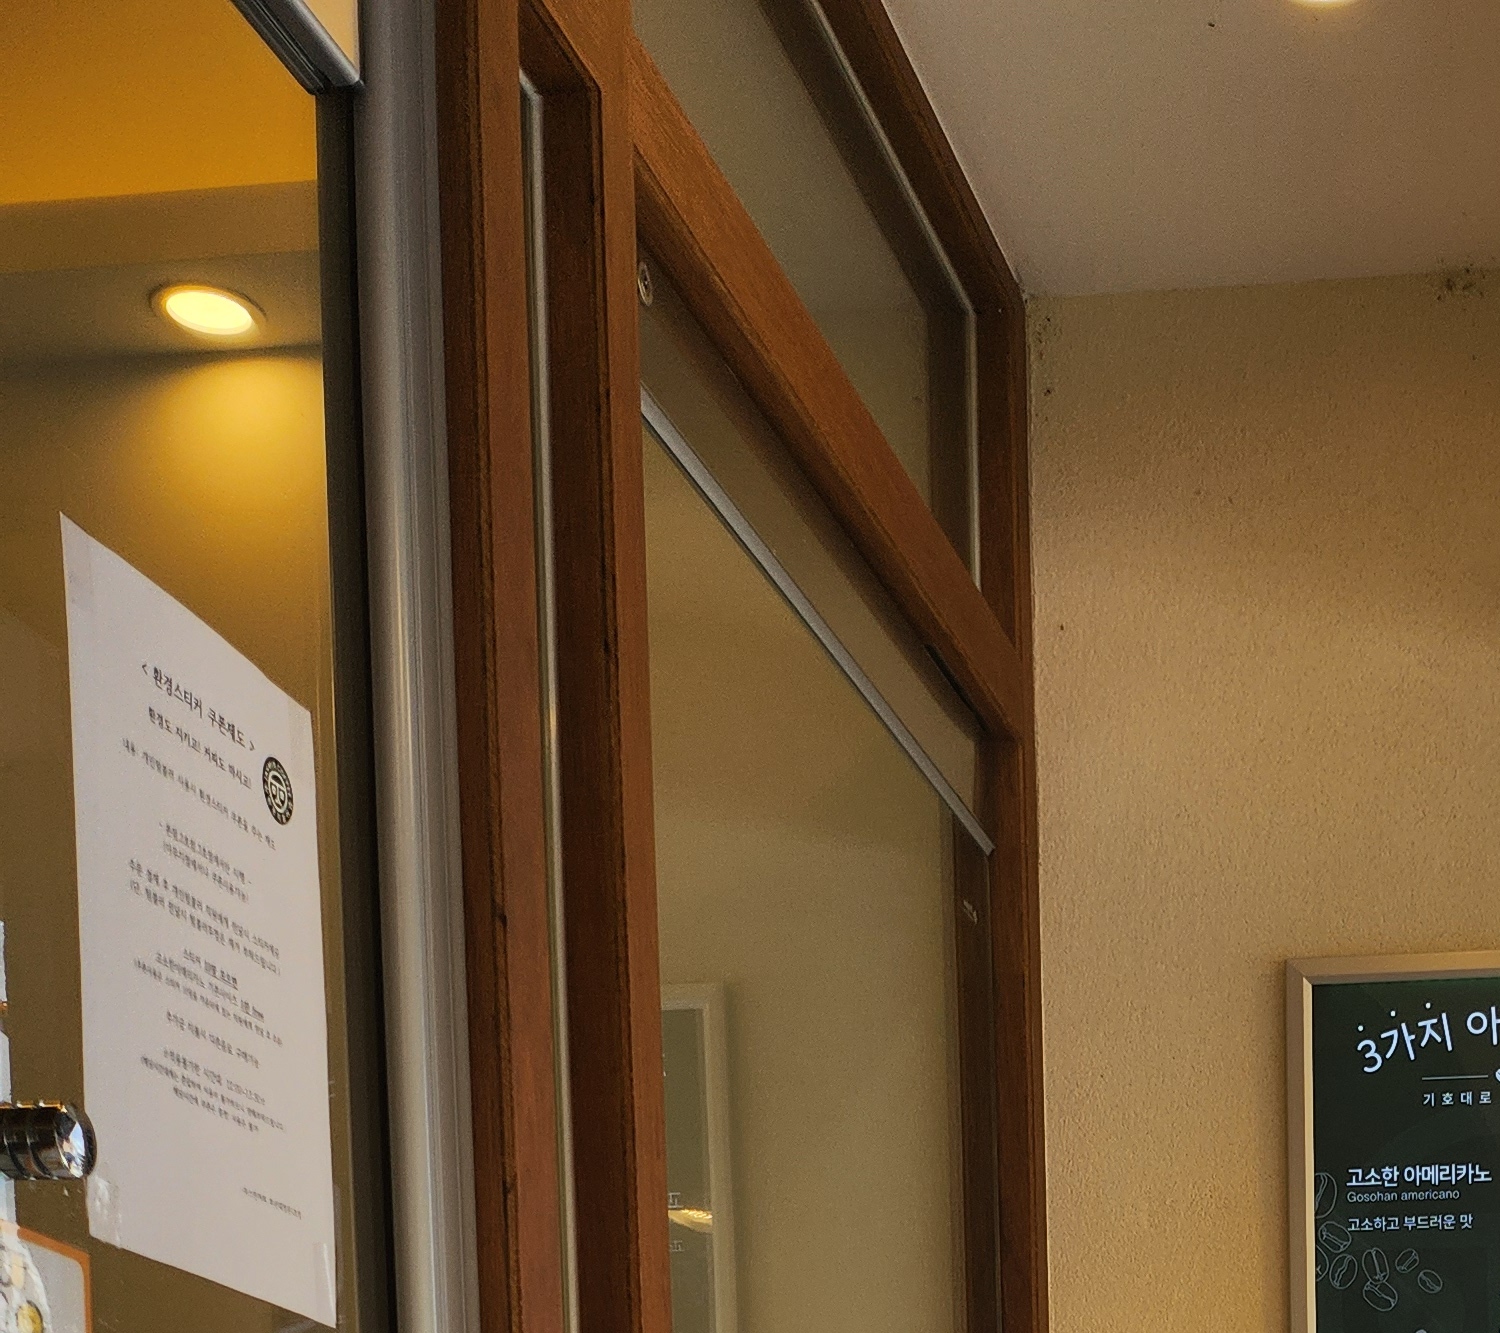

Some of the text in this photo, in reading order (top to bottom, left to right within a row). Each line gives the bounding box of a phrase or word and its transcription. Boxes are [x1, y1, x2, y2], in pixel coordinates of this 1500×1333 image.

[1357, 1012, 1453, 1073] 3가지
[1423, 1091, 1492, 1106] 기호대로
[1346, 1164, 1493, 1188] 고소한 아메리카노
[1347, 1189, 1460, 1203] Gosohan americano
[1347, 1214, 1474, 1232] 고소하고 부드러운 맛
